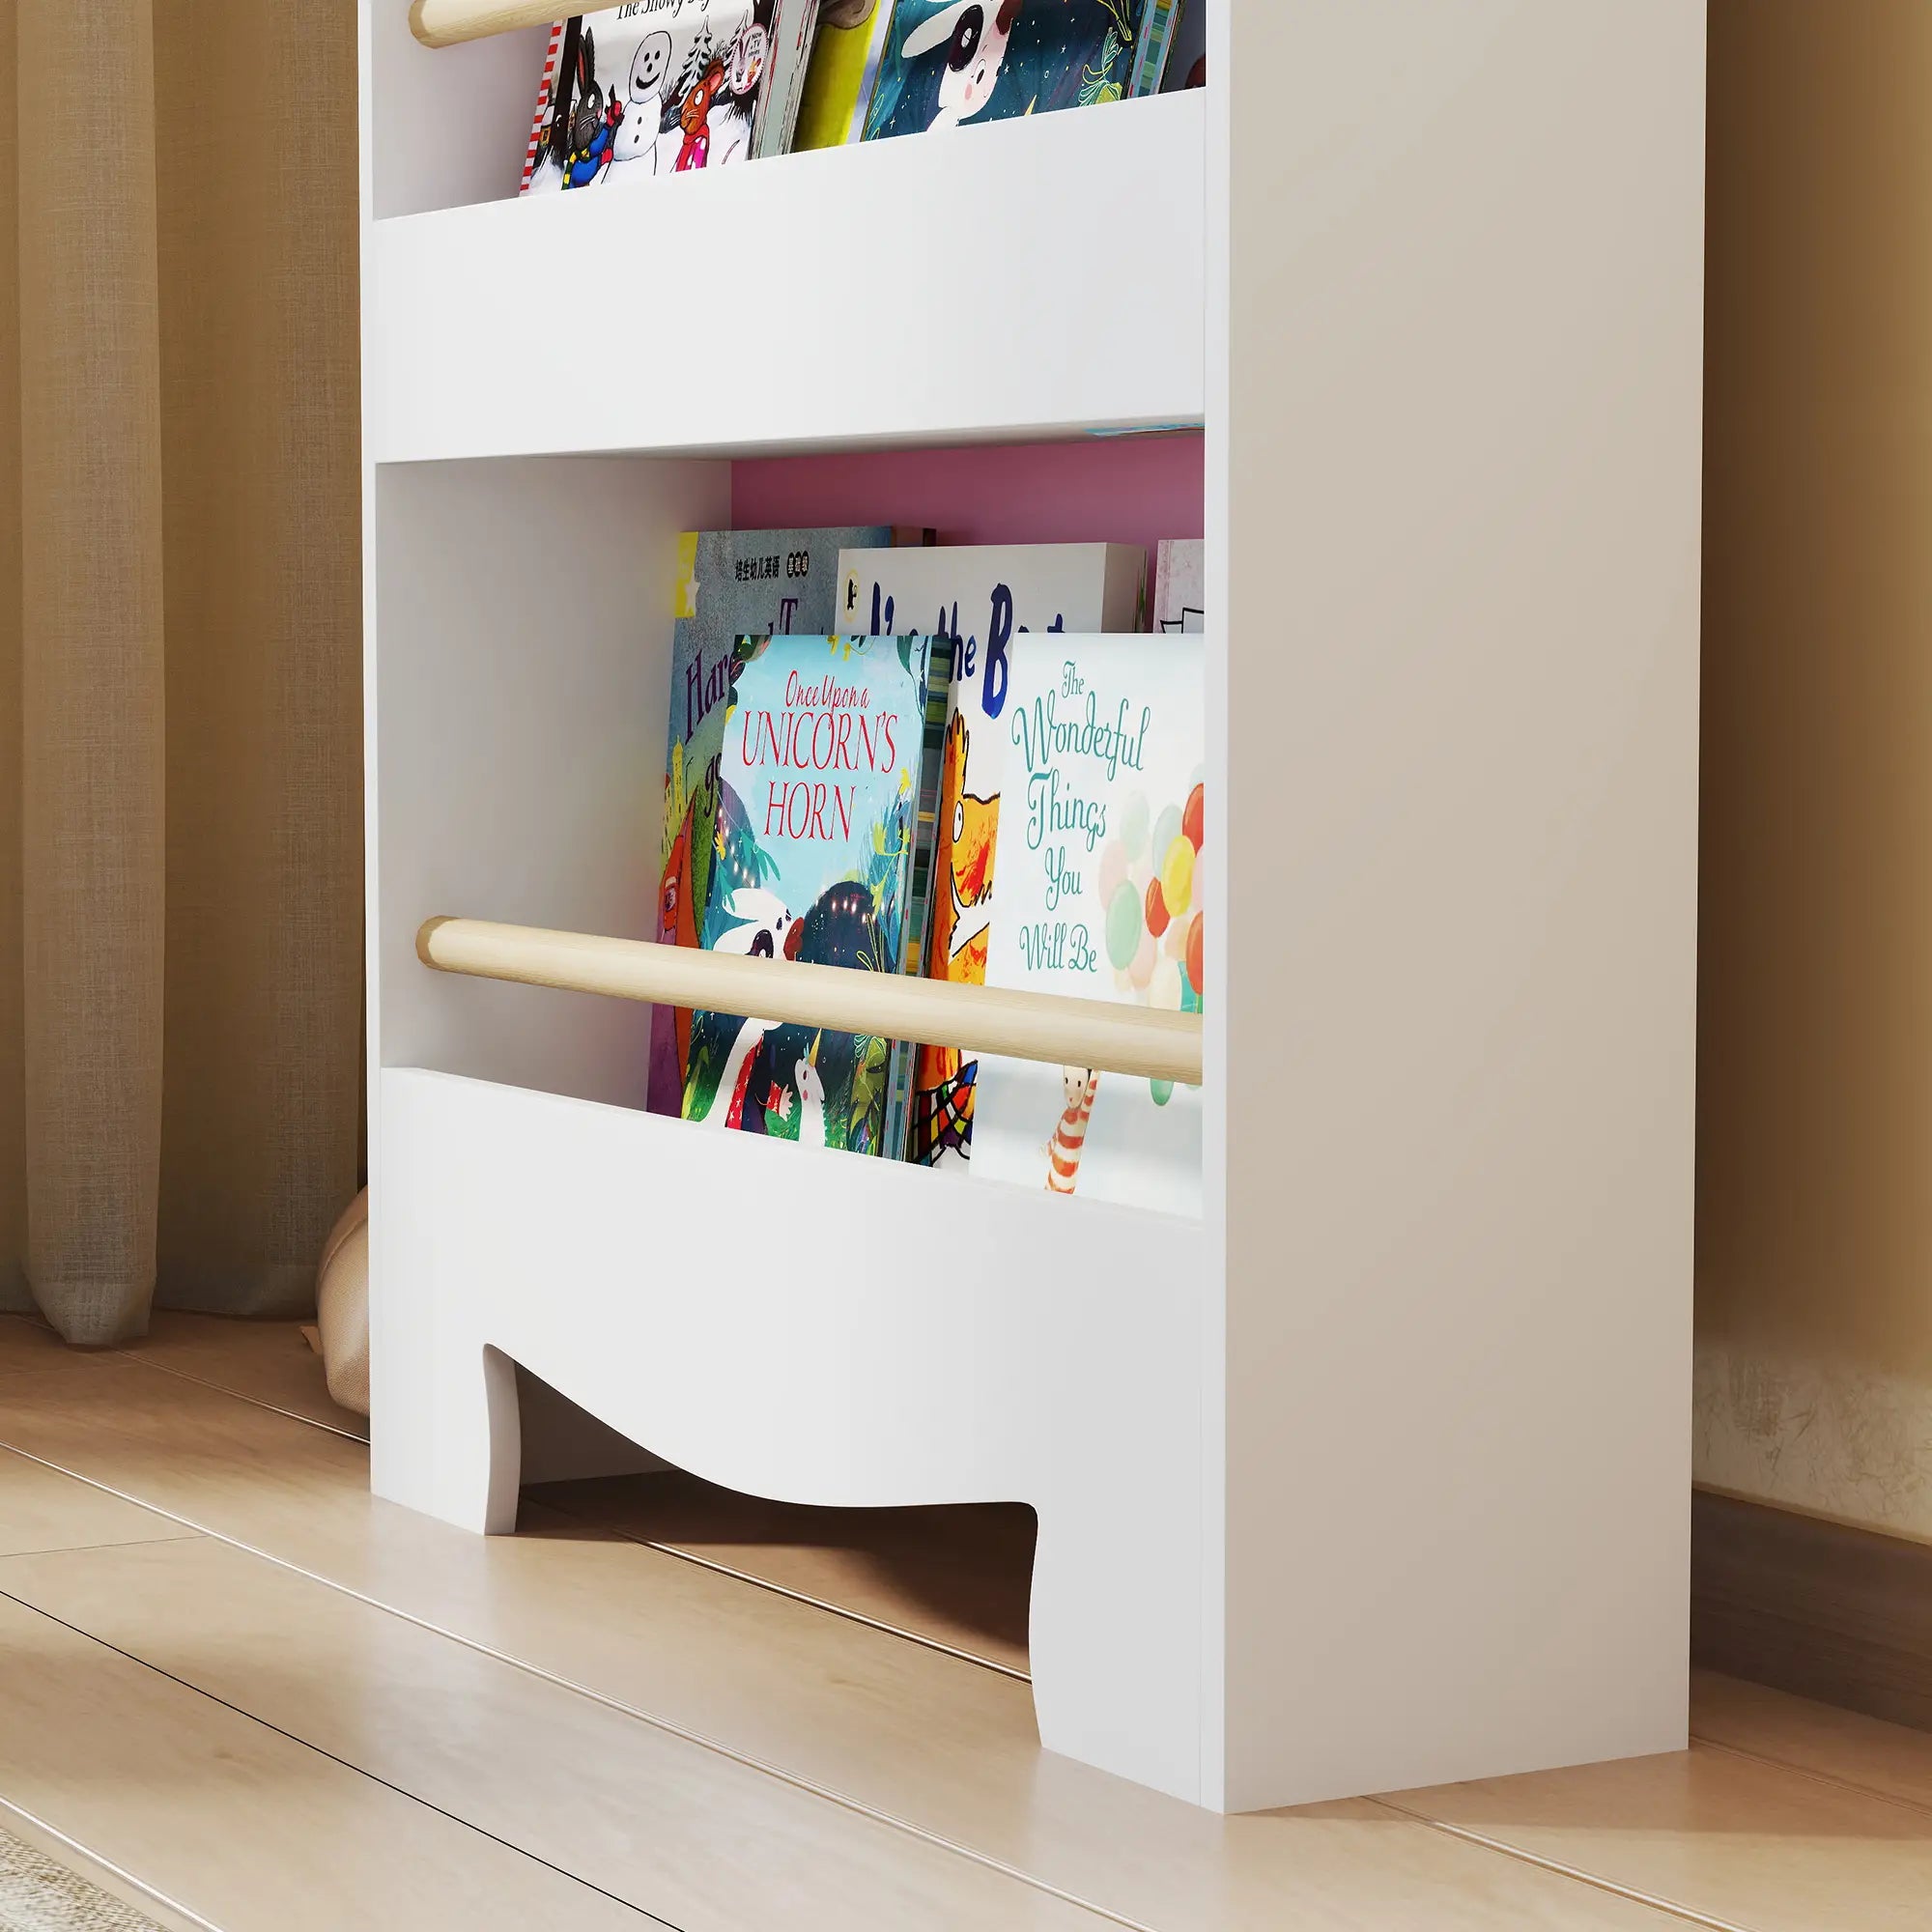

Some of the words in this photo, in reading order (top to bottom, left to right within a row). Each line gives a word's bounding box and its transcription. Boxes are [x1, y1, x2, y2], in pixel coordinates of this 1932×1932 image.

[735, 555, 780, 582] 培生幼儿英语
[685, 648, 731, 746] Har
[785, 669, 819, 708] Once
[821, 674, 859, 723] Upon
[860, 686, 870, 710] a
[1062, 661, 1085, 698] The
[741, 710, 898, 774] UNICORN'S
[1011, 689, 1151, 781] Wonderful
[763, 781, 857, 842] HORN
[1027, 767, 1106, 852] Things
[1044, 846, 1083, 911] You
[1019, 923, 1066, 972] Will
[1068, 923, 1097, 973] Be
